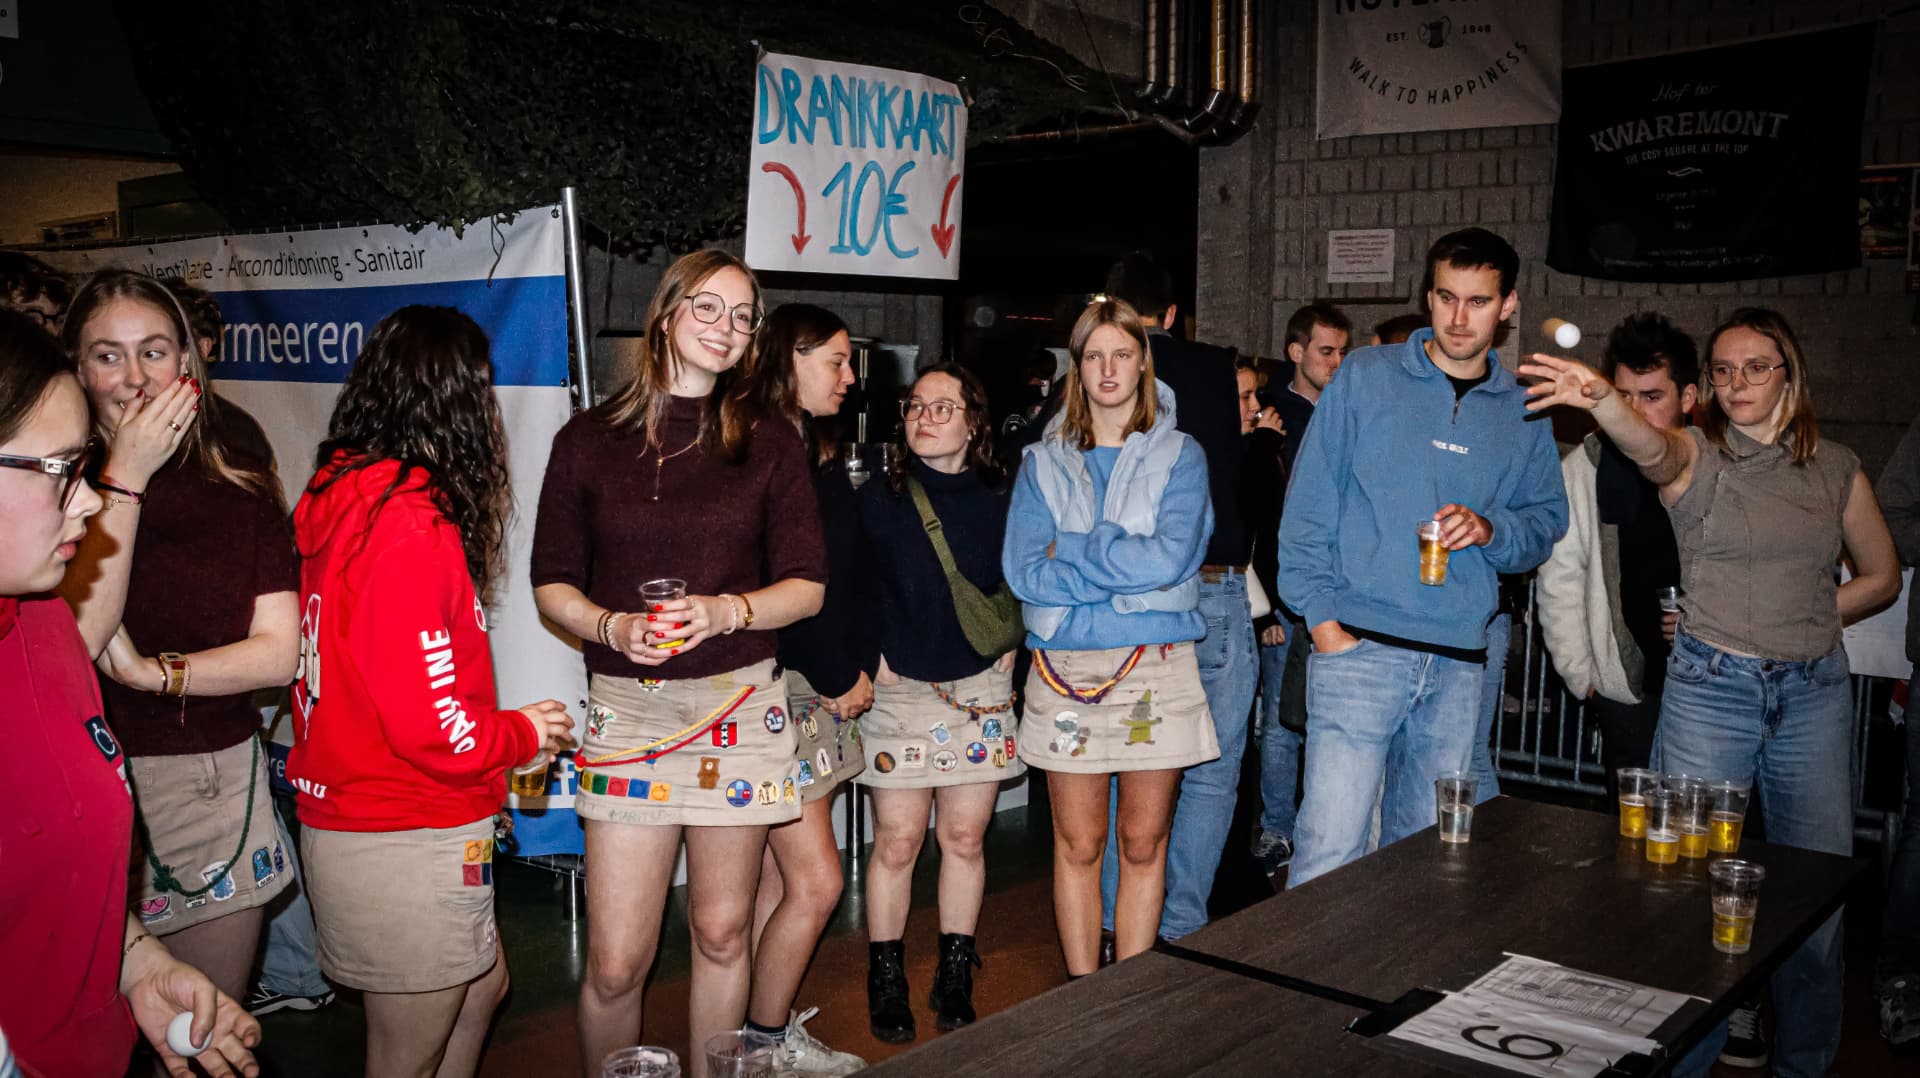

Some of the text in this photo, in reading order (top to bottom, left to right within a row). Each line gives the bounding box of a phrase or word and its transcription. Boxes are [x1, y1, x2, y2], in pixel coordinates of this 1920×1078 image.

[1386, 32, 1409, 42] EST.
[1350, 41, 1528, 105] WALK TO HAPPINESS
[758, 63, 962, 160] DRANKKAART
[1589, 110, 1789, 153] KWAREMONT
[821, 160, 919, 259] 10€
[354, 244, 425, 273] Sanitair
[208, 321, 363, 365] rmeeren
